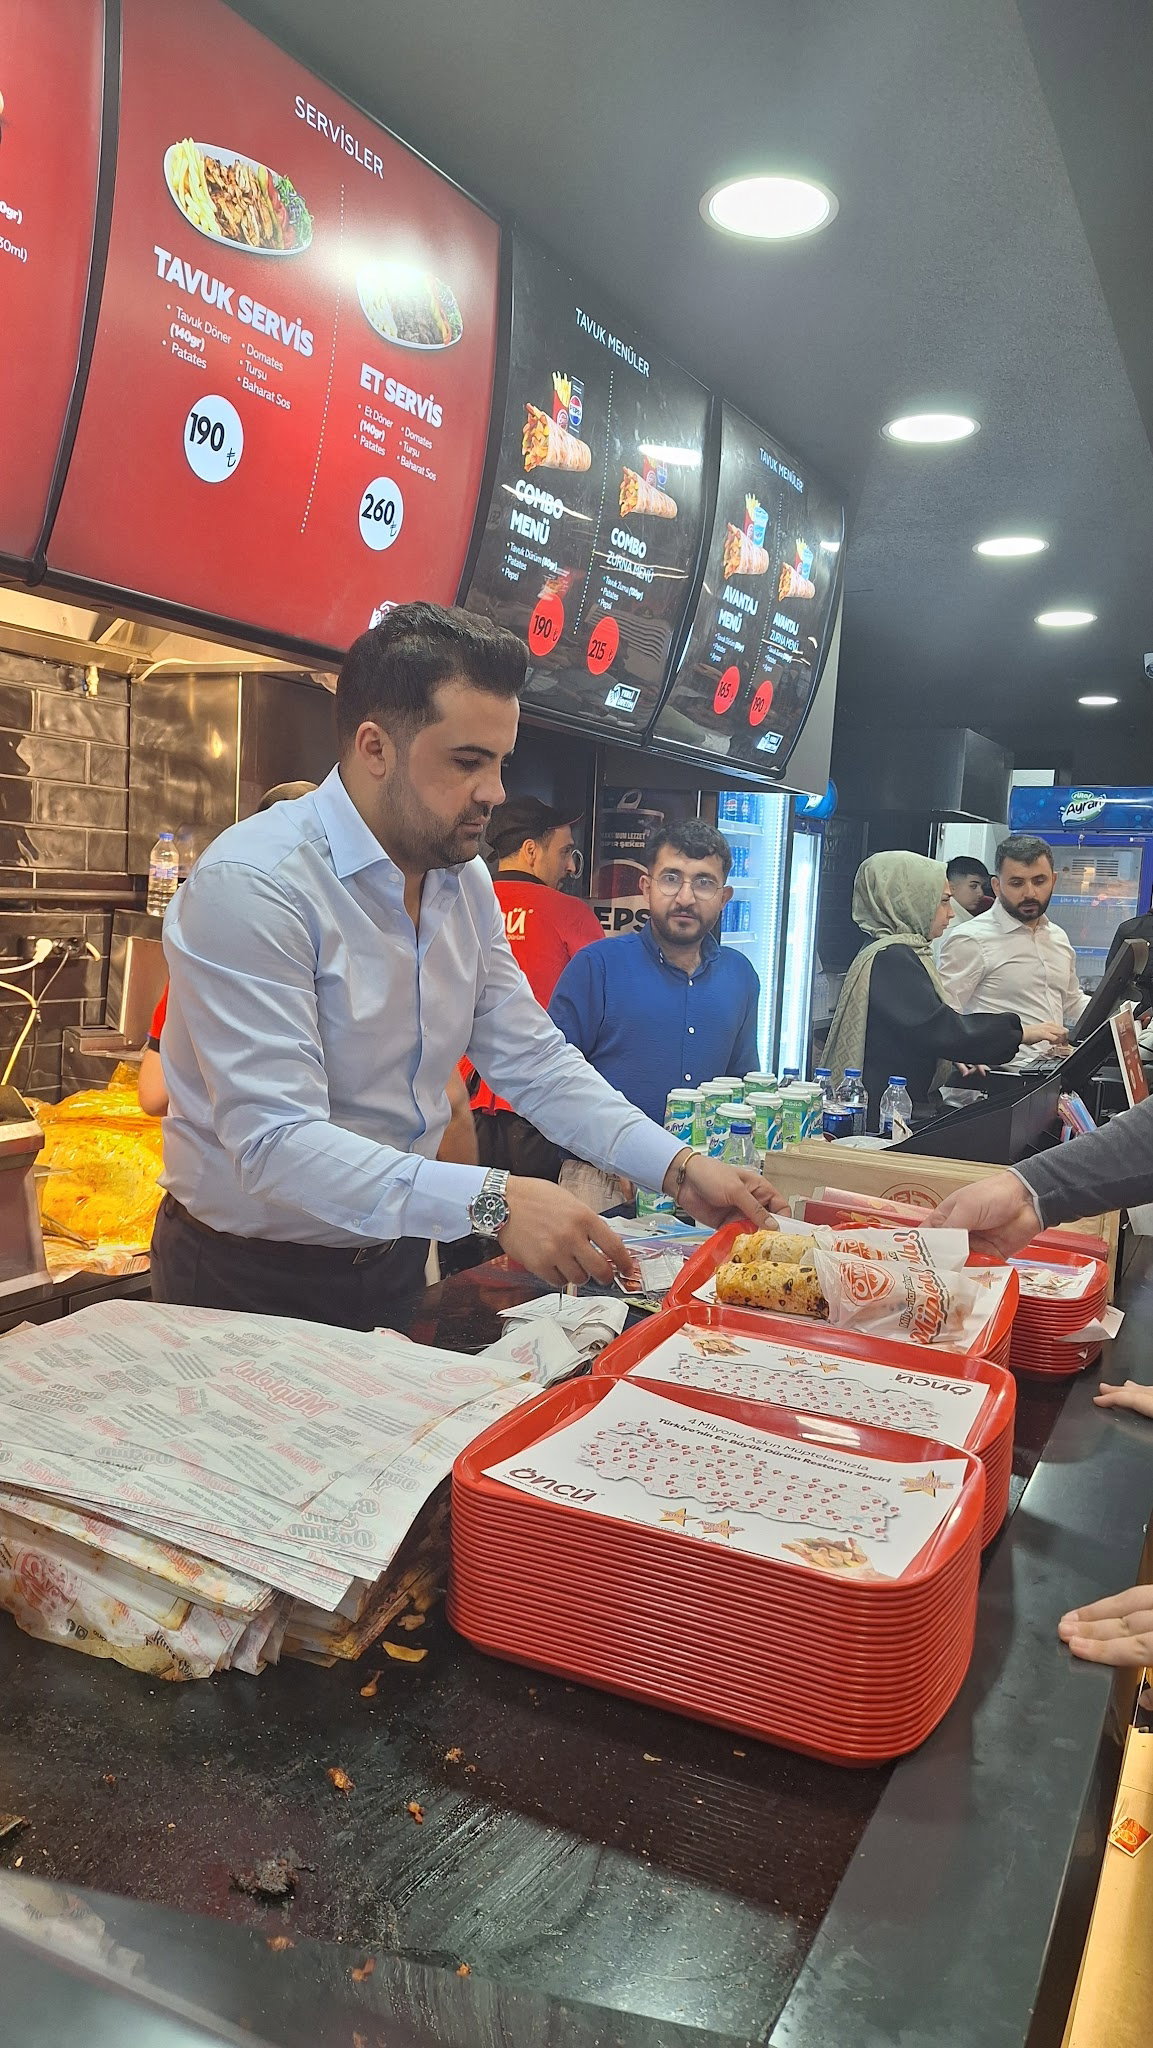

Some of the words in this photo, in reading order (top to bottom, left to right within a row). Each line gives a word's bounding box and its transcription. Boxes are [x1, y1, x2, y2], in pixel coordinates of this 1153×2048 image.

[294, 95, 384, 180] SERVİSLER
[154, 245, 235, 316] TAVUK
[237, 294, 314, 357] SERVİS
[170, 323, 205, 352] (140gr)
[176, 306, 203, 331] Tavuk
[204, 321, 232, 344] Döner
[171, 342, 207, 369] Patates
[575, 307, 606, 345] TAVUK
[608, 333, 650, 378] MENÜLER
[245, 360, 267, 381] Turşu
[246, 343, 283, 371] Domates
[242, 377, 275, 403] Baharat
[276, 394, 291, 410] Sos
[360, 362, 384, 395] ET
[384, 377, 443, 428] SERVİS
[364, 405, 373, 418] Et
[373, 411, 394, 429] Döner
[190, 412, 225, 452] 190
[360, 435, 386, 456] Patates
[404, 427, 432, 450] Domates
[403, 441, 420, 458] Turşu
[400, 455, 425, 476] Baharat
[425, 467, 437, 482] Sos
[760, 447, 778, 473] TAVUK
[778, 463, 804, 494] MENÜLER
[361, 493, 395, 526] 260
[516, 479, 564, 520] COMBO
[509, 509, 551, 545] MENÜ
[611, 527, 647, 559] COMBO
[504, 567, 520, 581] Pepsi
[507, 555, 527, 571] Patates
[606, 550, 632, 573] ZURNA
[632, 564, 654, 584] MENÜ
[723, 585, 759, 616] AVANTAJ
[533, 615, 552, 639] 190
[718, 608, 743, 634] MENÜ
[772, 612, 800, 636] AVANTAJ
[588, 639, 607, 660] 215
[718, 681, 731, 698] 165
[1066, 798, 1102, 816] Ayran
[619, 841, 646, 849] ŞEKER
[698, 1421, 745, 1440] Milyonu
[783, 1445, 869, 1472] Müptelamızla
[715, 1435, 728, 1443] En
[729, 1439, 762, 1452] Büyük
[764, 1448, 801, 1462] Dürüm
[802, 1457, 854, 1476] Restoran
[854, 1471, 892, 1484] Zinciri
